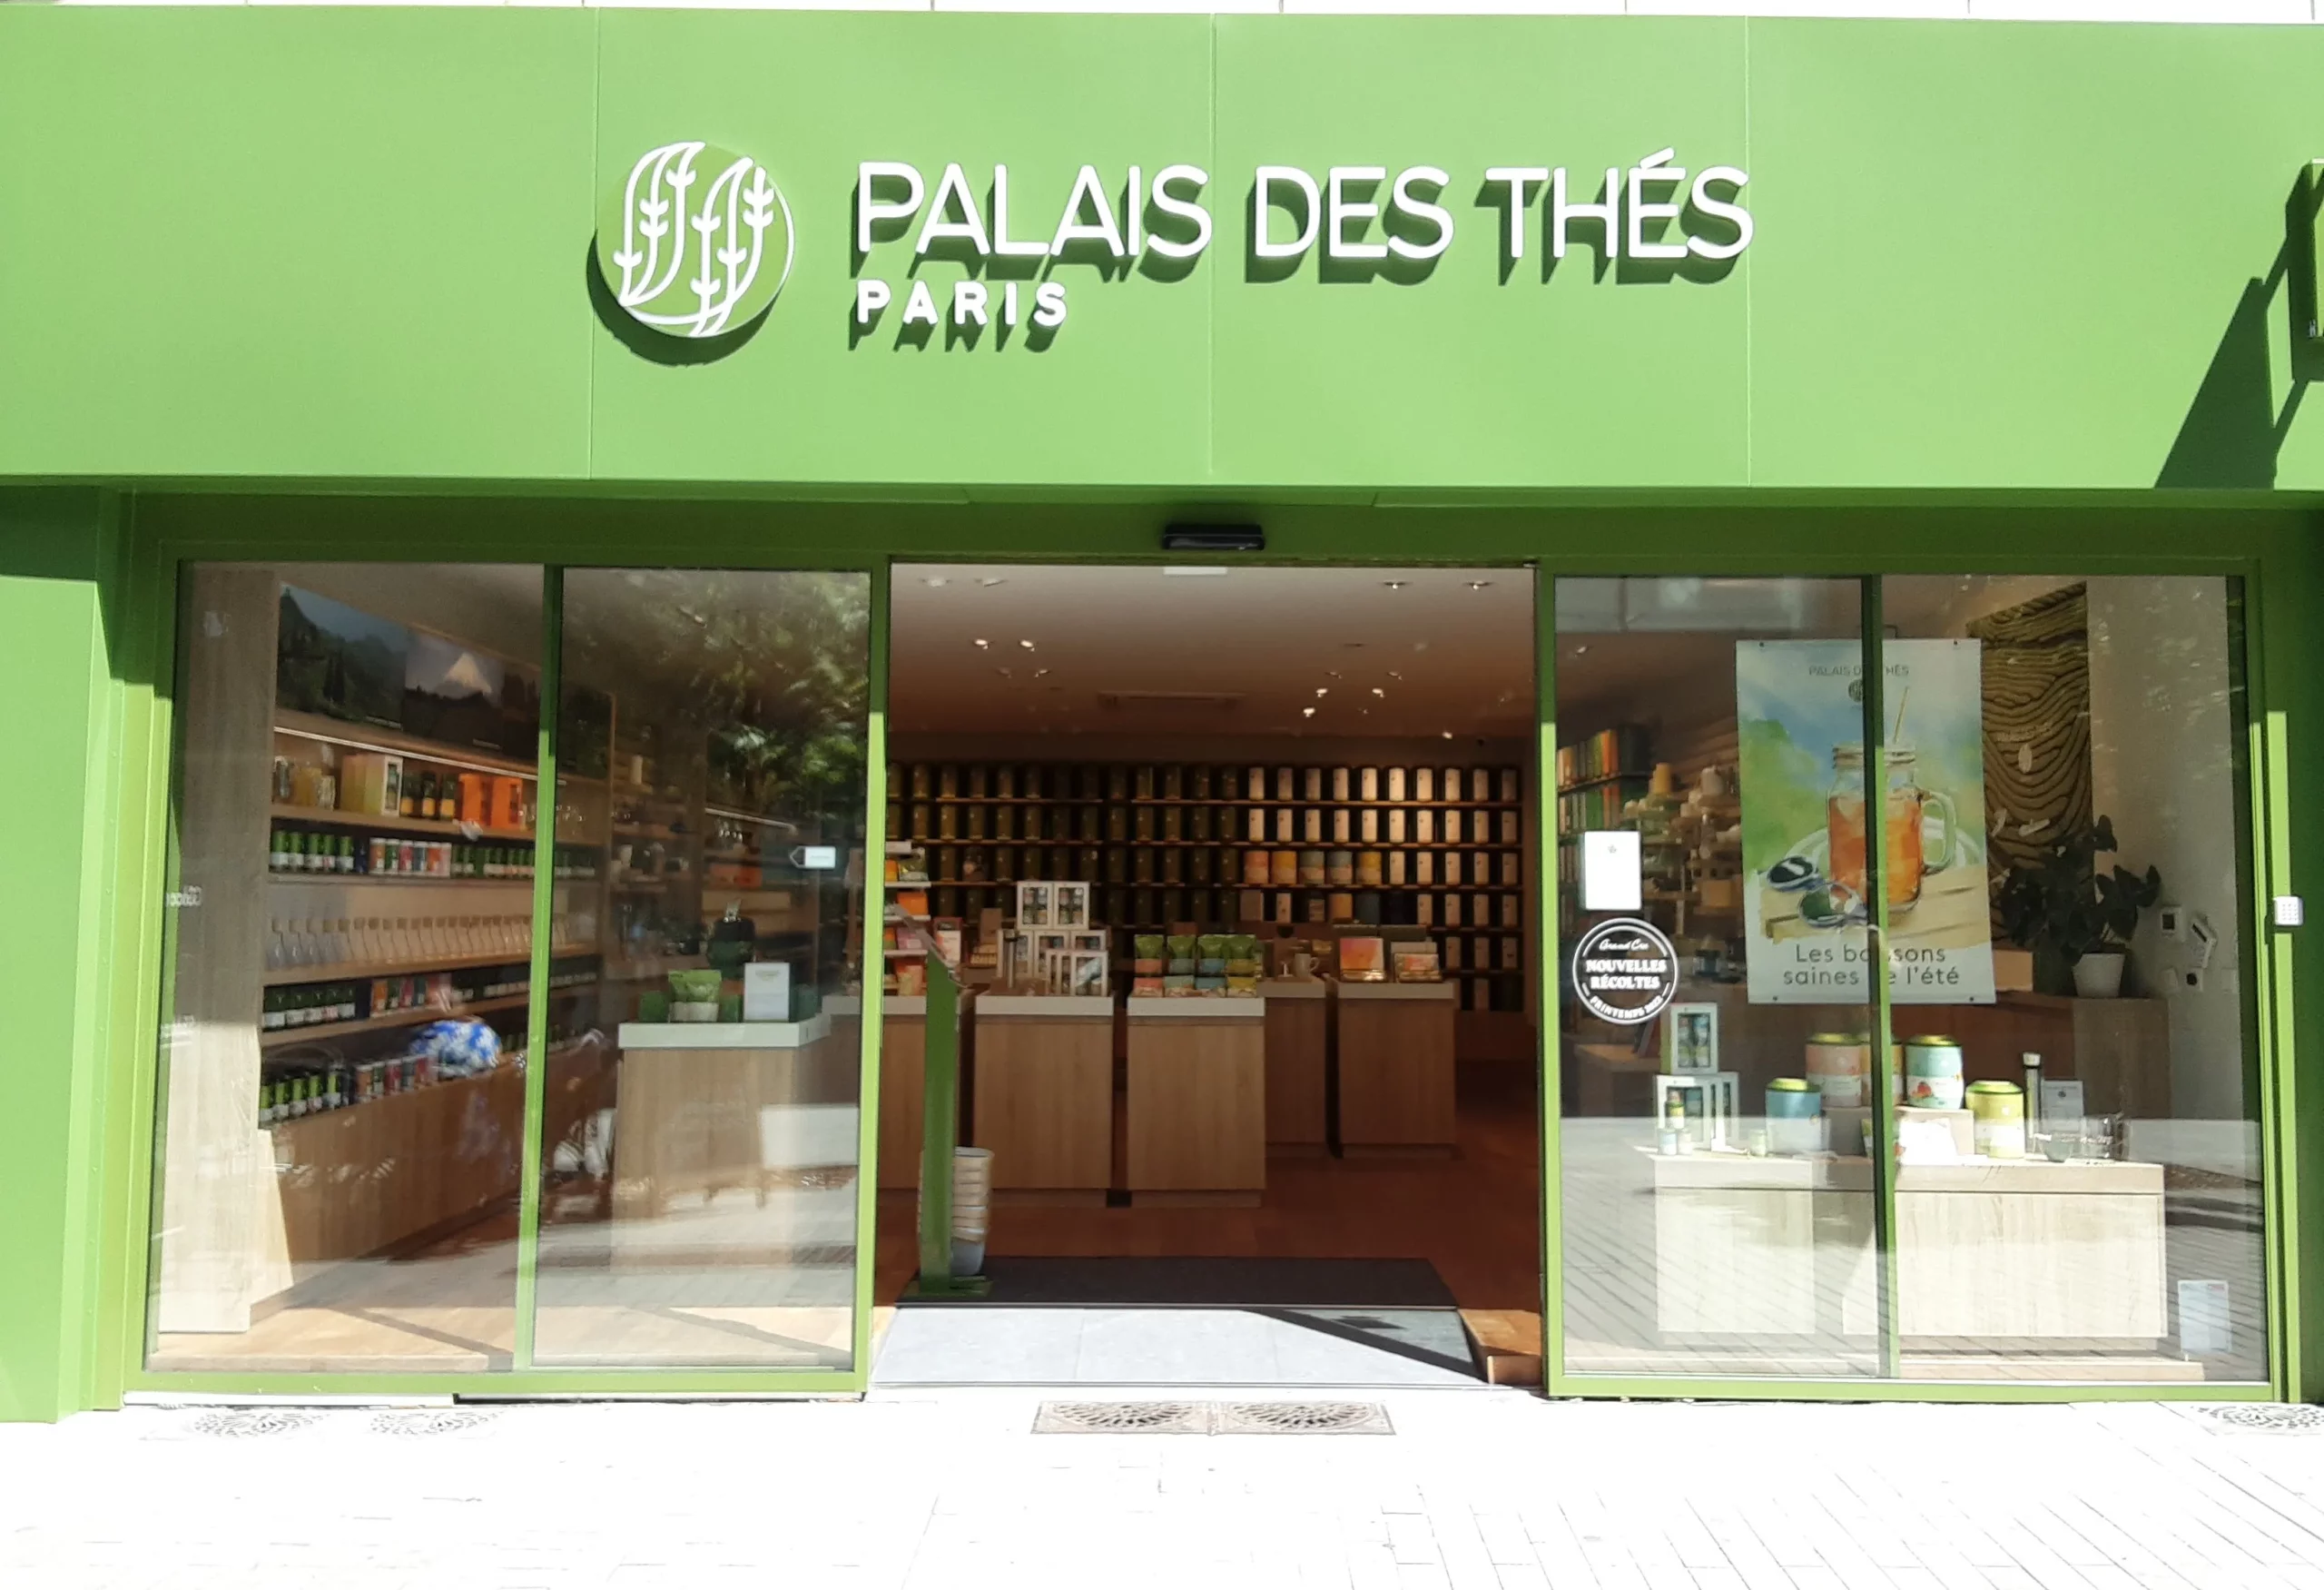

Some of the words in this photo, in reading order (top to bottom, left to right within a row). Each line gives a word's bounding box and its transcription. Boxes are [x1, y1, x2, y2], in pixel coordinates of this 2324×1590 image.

[857, 161, 1213, 258] PALAIS
[1255, 164, 1454, 260] DES
[1484, 146, 1756, 261] THÉS
[856, 279, 1067, 327] PARIS
[1808, 665, 1851, 676] PALAIS
[1599, 938, 1632, 951] Grand
[1630, 938, 1649, 951] Cru
[1796, 943, 1834, 963] Les
[1843, 943, 1945, 963] bosons
[1585, 959, 1668, 973] NOUVELLES
[1783, 966, 1860, 985] saines
[1906, 965, 1959, 985] l'été
[1590, 973, 1660, 990] RÉCOLTES
[1589, 995, 1645, 1019] PRINTEMPS
